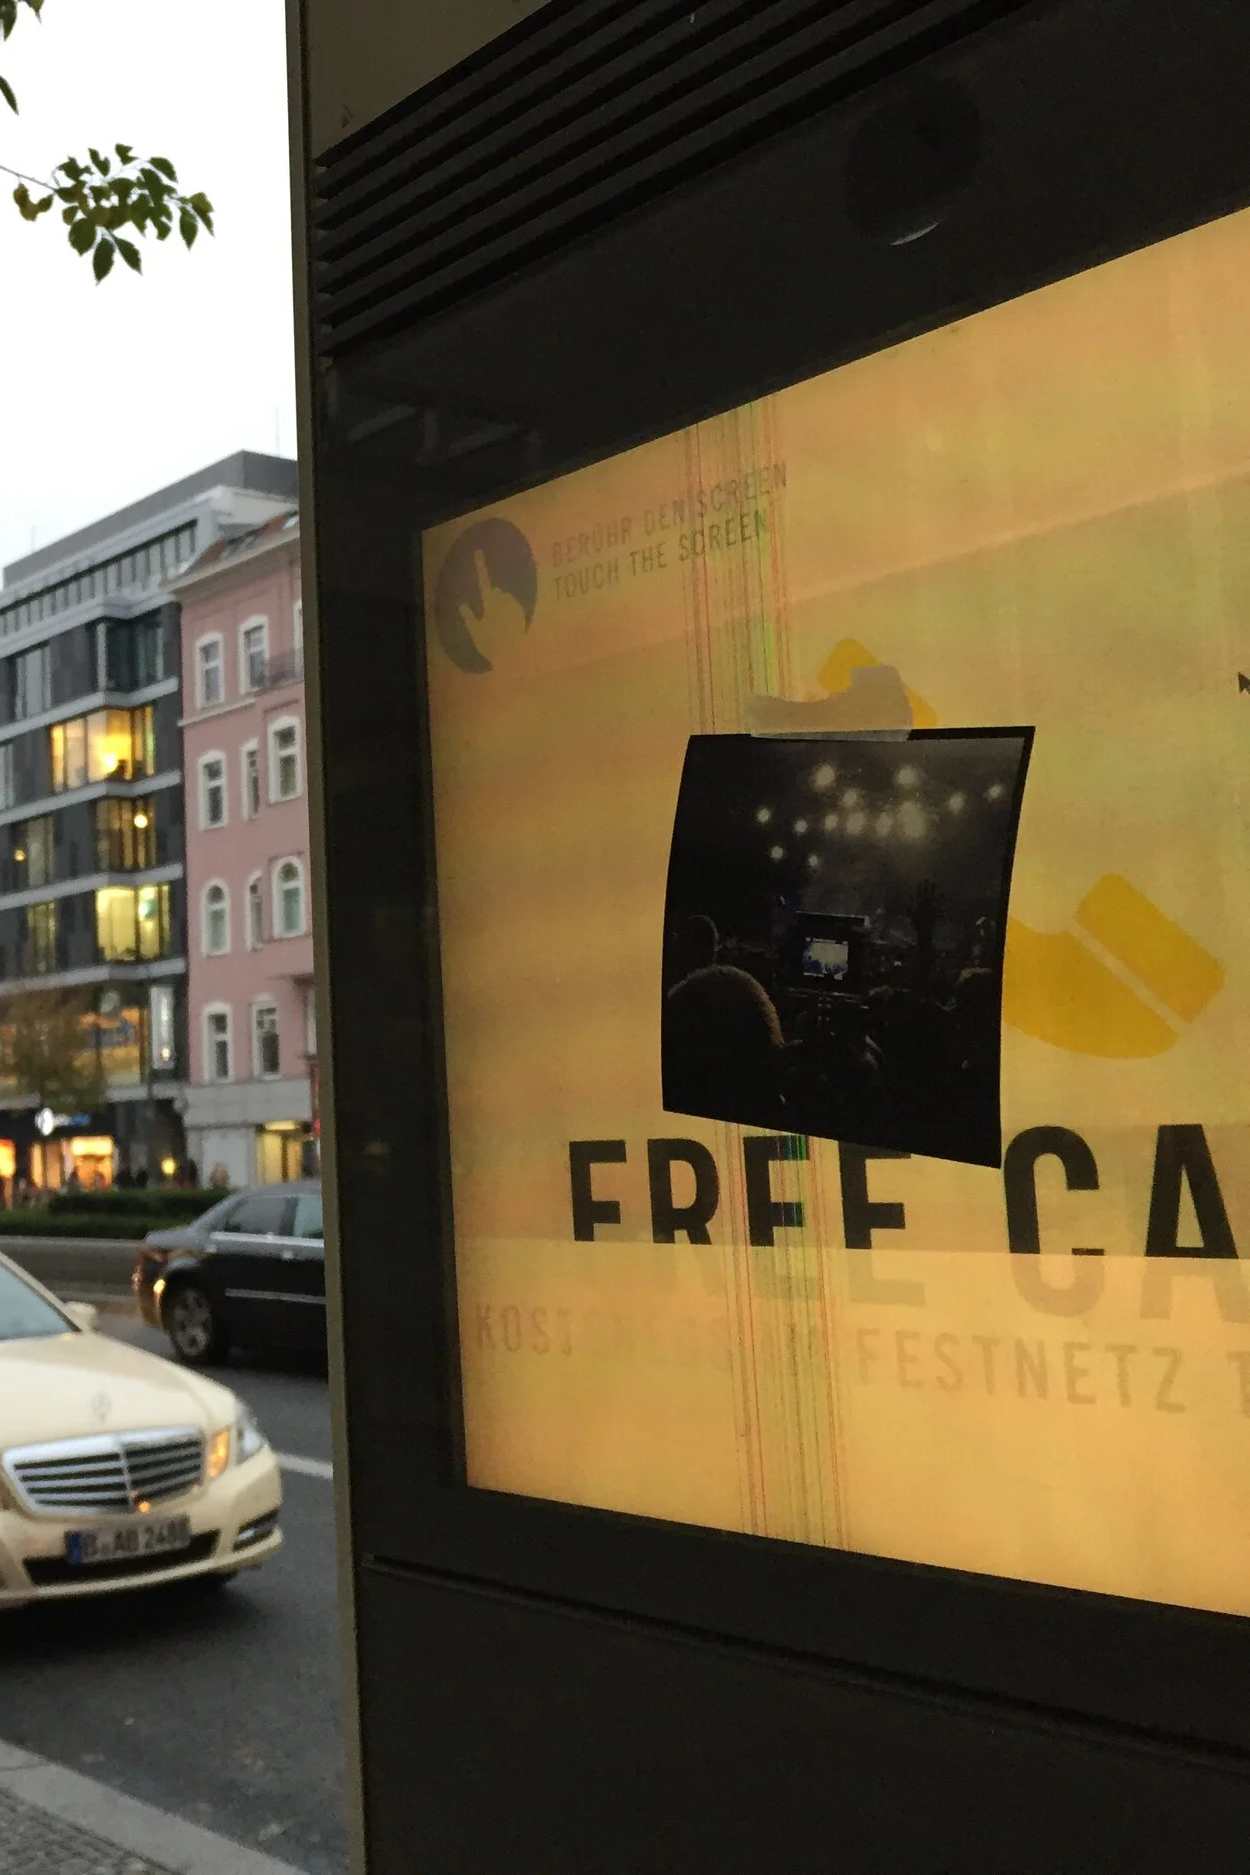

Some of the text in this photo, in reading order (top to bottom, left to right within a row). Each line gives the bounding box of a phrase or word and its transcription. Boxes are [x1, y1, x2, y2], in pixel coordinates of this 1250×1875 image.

[642, 498, 686, 537] DEN
[696, 461, 788, 518] SCREEN
[552, 508, 769, 602] TOUCH THE SCREEN
[569, 1134, 927, 1306] FREE
[855, 1327, 1188, 1414] FESTNETZ
